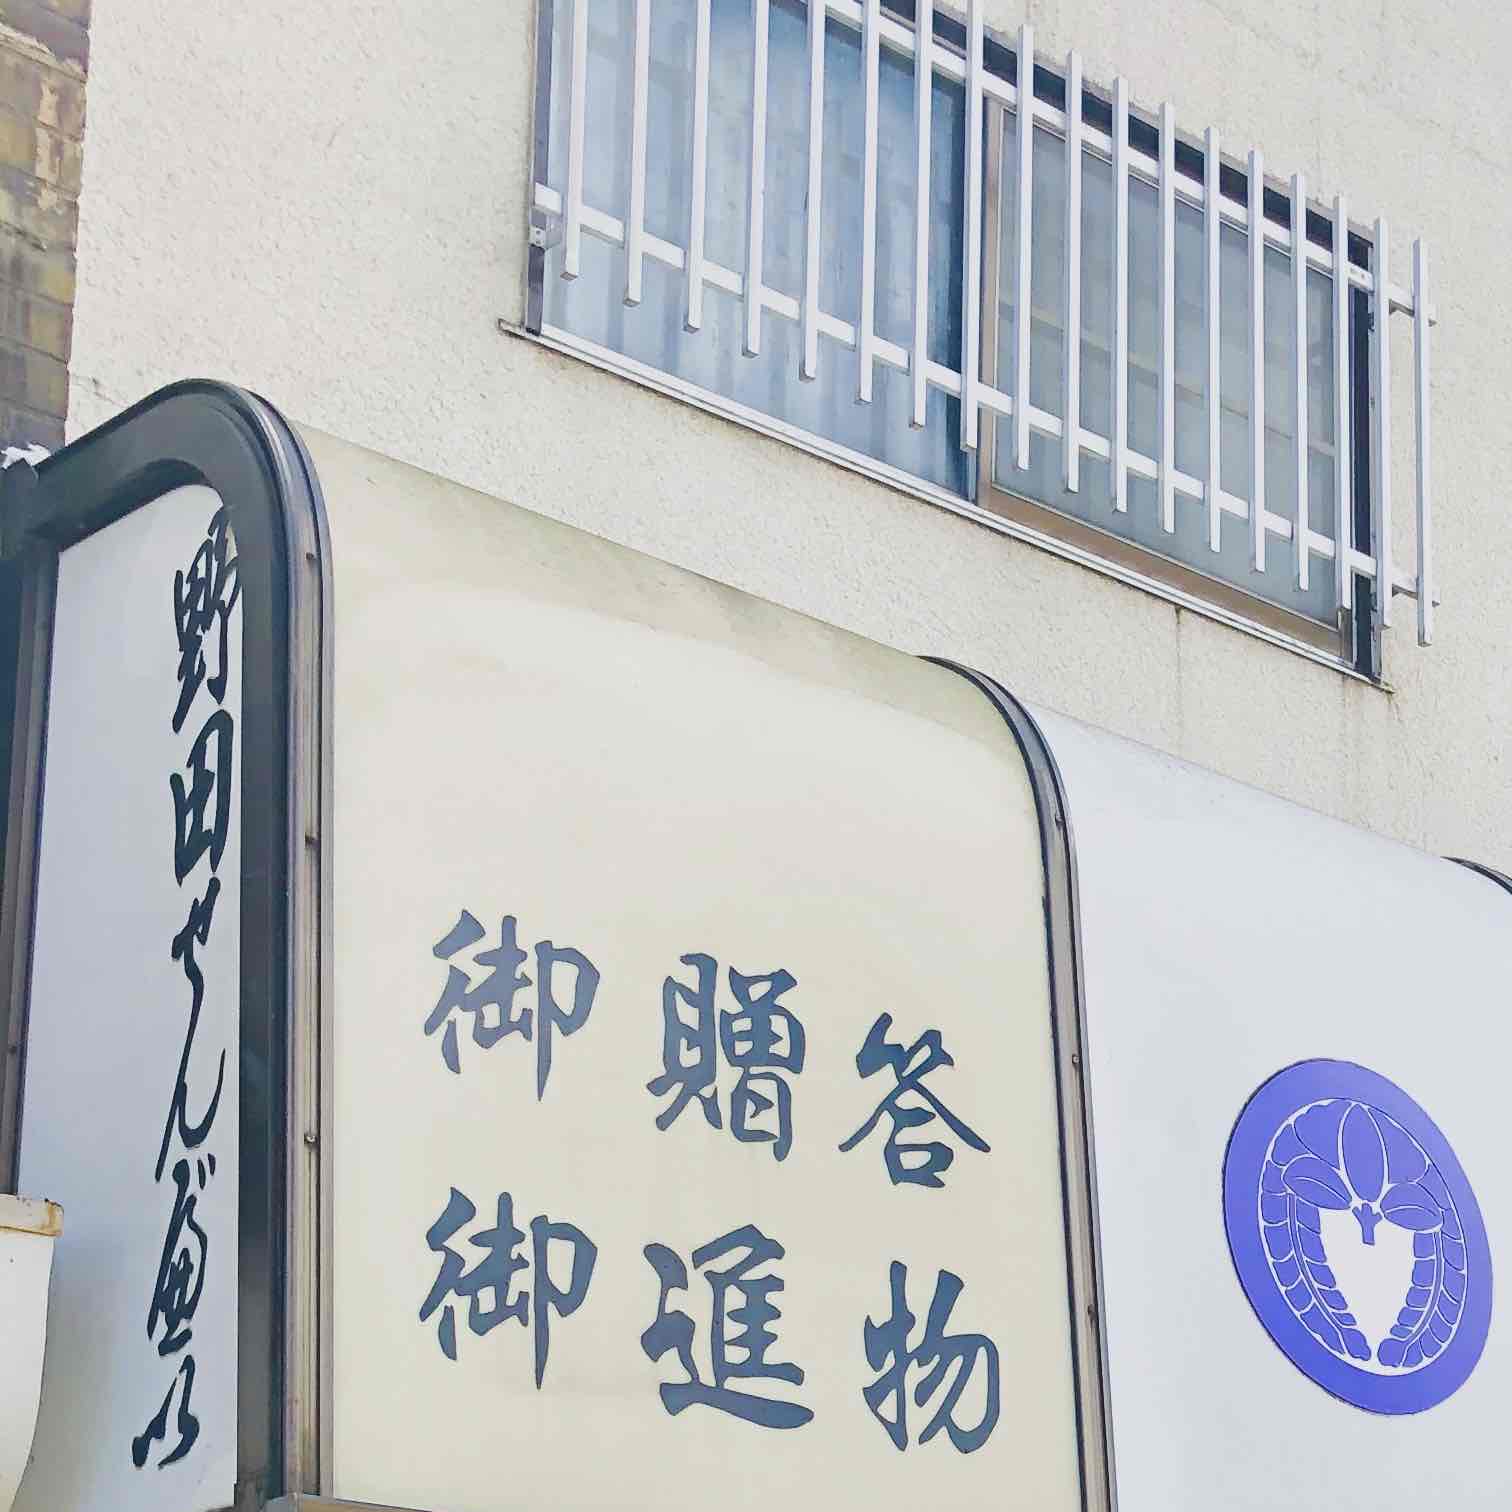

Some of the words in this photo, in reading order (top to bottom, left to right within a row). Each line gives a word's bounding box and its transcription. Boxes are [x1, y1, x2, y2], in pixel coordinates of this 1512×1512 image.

[423, 908, 991, 1190] 御贈答
[419, 1186, 1003, 1458] 御進物
